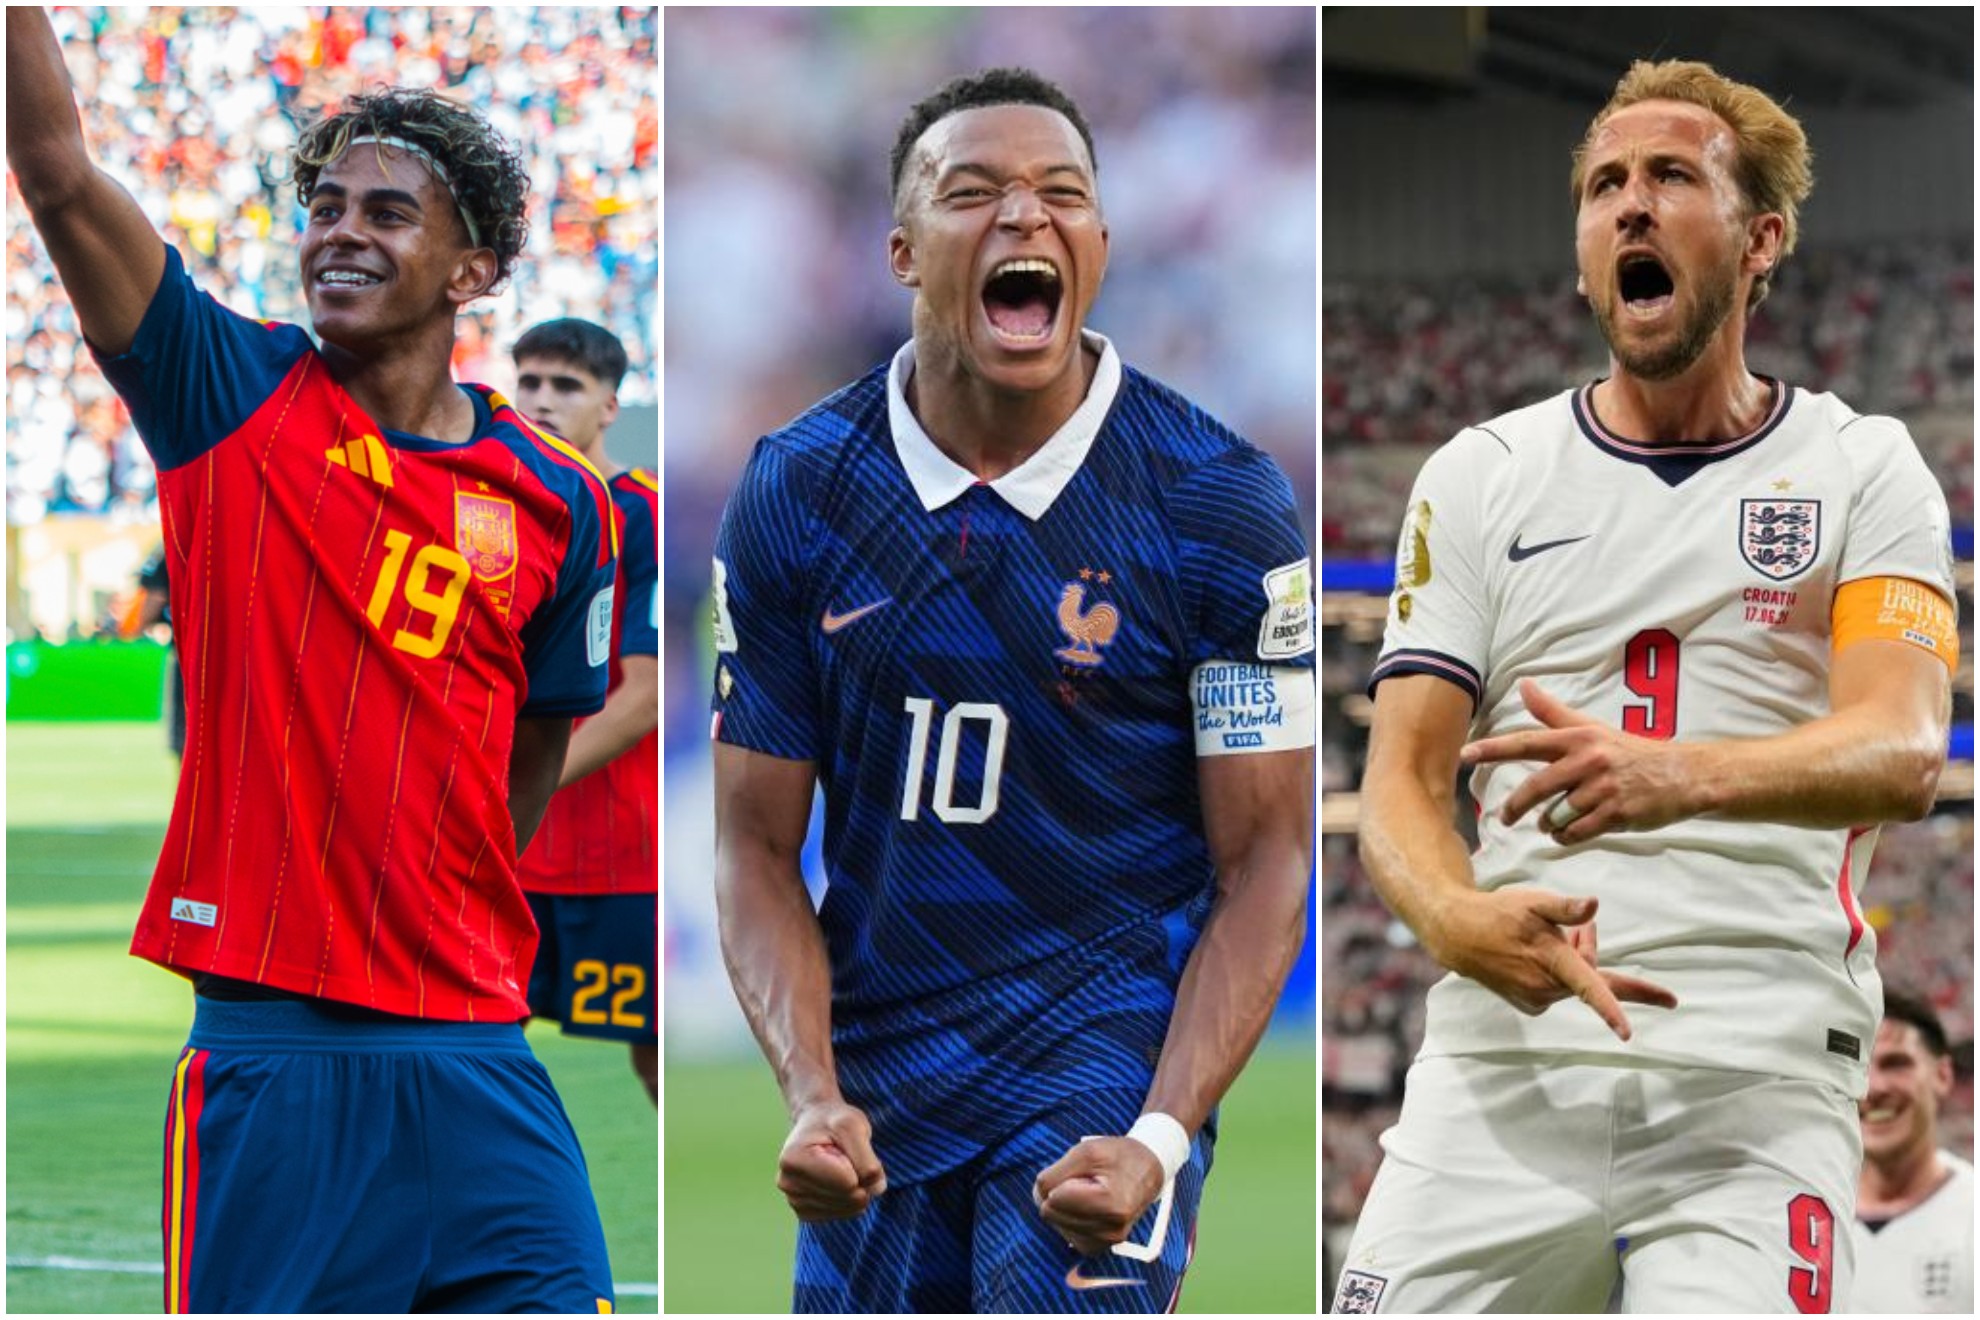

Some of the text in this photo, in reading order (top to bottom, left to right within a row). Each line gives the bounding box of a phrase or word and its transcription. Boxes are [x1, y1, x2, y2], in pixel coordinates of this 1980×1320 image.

[366, 528, 472, 659] 19
[1197, 663, 1275, 684] FOOTBALL
[1197, 680, 1277, 709] UNITES
[1622, 627, 1680, 740] 9
[1196, 705, 1283, 732] the World
[1225, 733, 1261, 747] FIFA
[900, 696, 1010, 824] 10
[571, 958, 646, 1029] 22
[1787, 1192, 1835, 1314] 9
